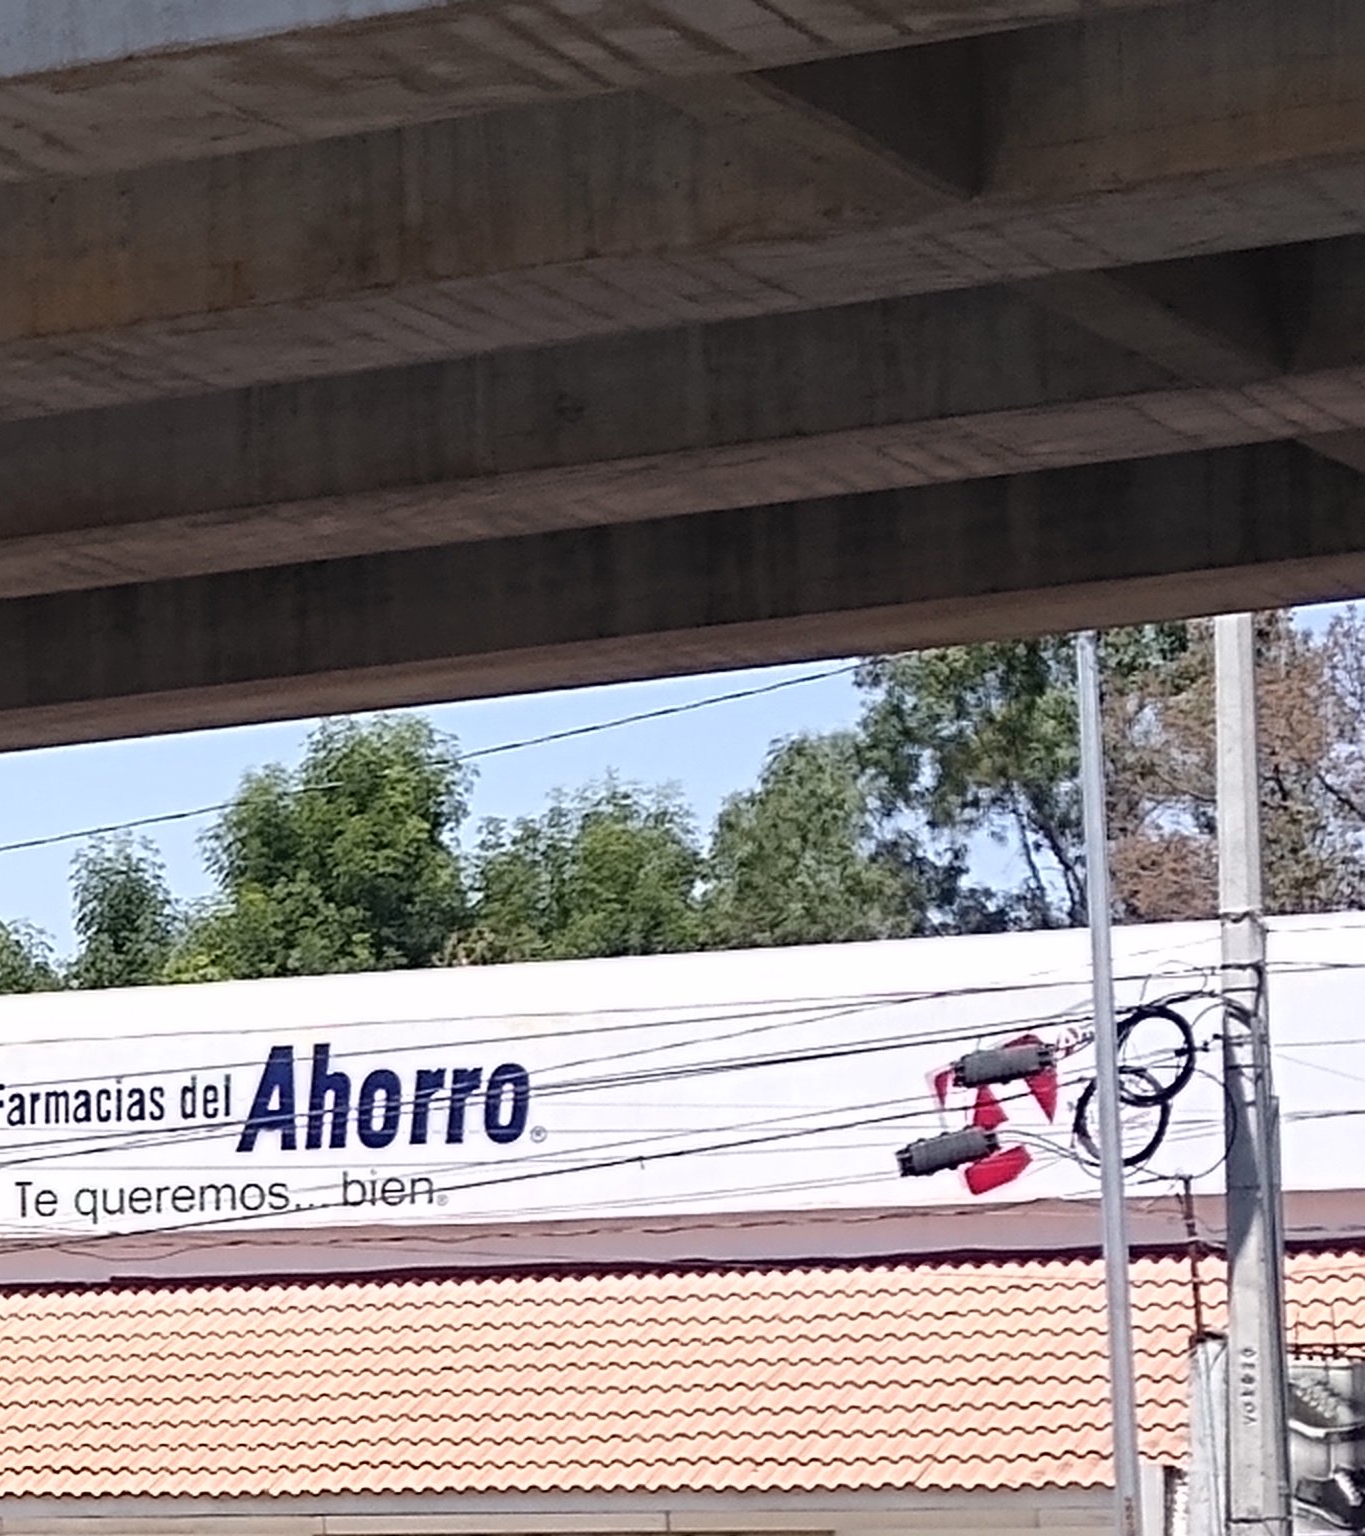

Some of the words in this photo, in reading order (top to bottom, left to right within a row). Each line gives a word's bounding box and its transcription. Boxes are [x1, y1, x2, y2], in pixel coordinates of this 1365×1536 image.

[181, 1073, 231, 1120] del
[236, 1043, 530, 1152] Ahorro
[15, 1181, 59, 1218] Te
